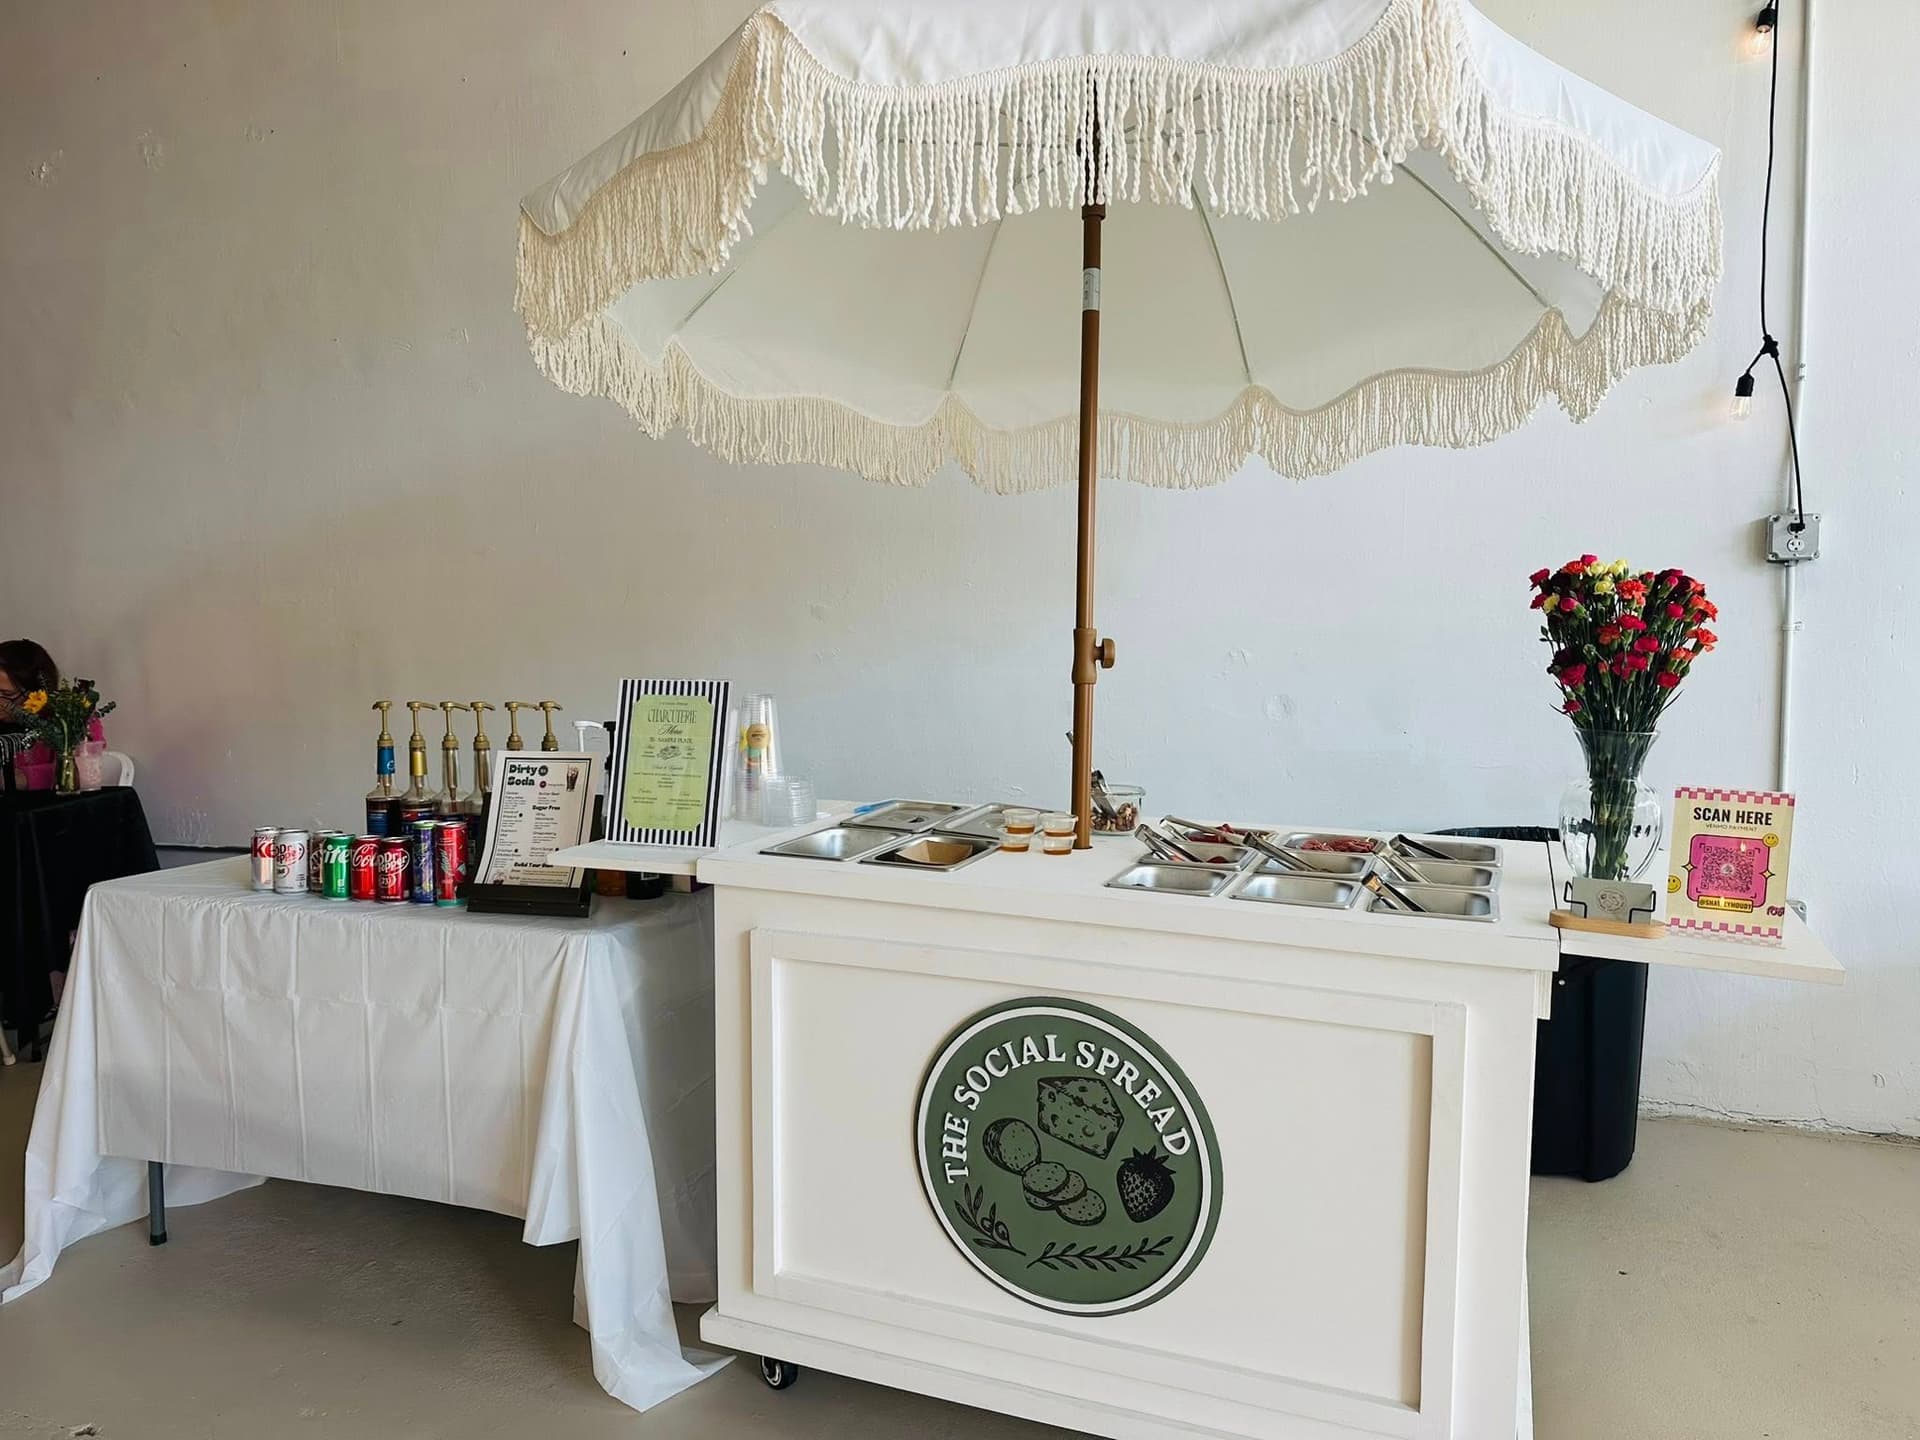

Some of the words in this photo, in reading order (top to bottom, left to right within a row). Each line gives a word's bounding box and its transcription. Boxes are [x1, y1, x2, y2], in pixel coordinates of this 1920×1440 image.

[509, 764, 538, 776] Dirty
[507, 776, 535, 786] Soda
[1693, 807, 1731, 822] SCAN
[1736, 810, 1773, 826] HERE
[384, 851, 398, 863] Dr
[953, 1034, 1067, 1111] SOCIAL
[1075, 1040, 1191, 1156] SPREAD
[942, 1112, 970, 1184] THE
